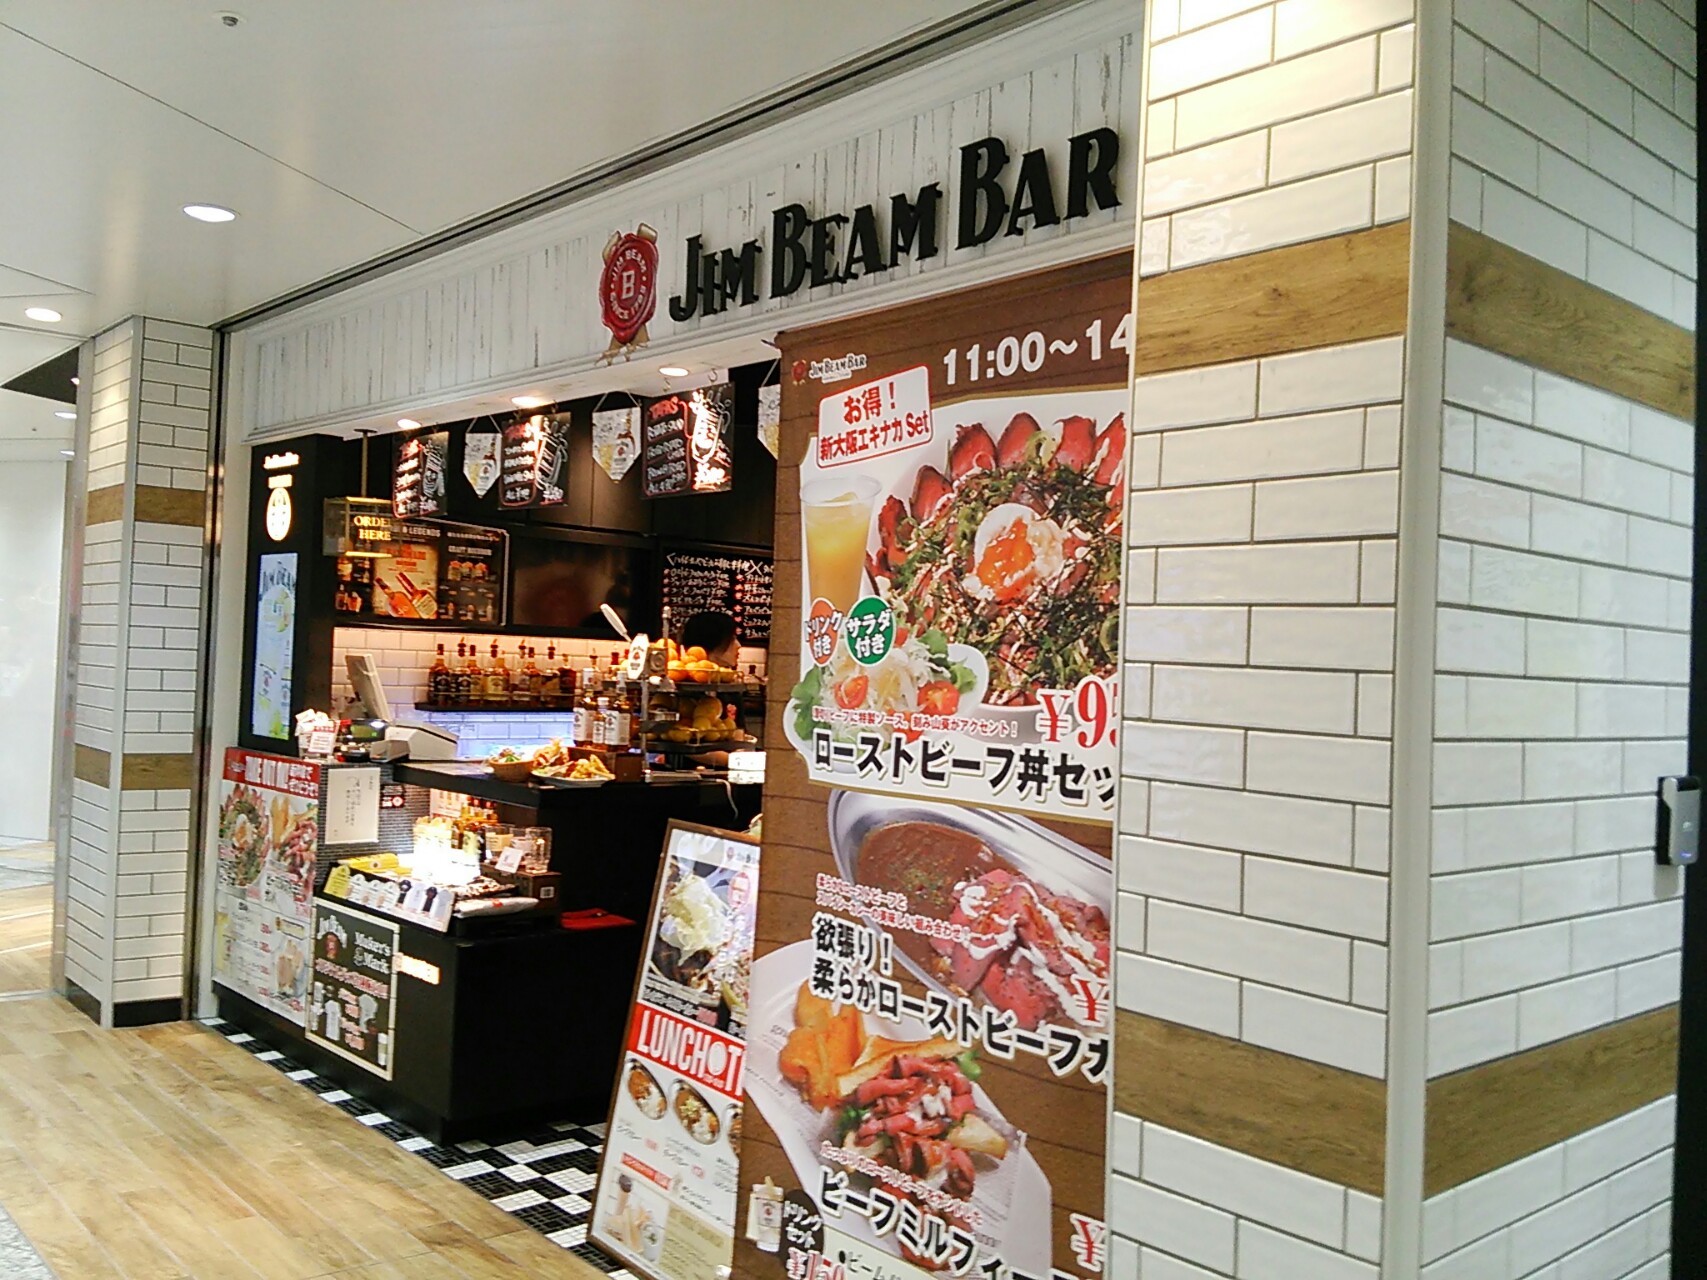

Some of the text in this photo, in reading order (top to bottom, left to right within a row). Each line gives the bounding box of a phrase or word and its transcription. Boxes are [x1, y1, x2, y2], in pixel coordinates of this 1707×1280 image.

[669, 126, 1122, 323] JIM BEAM BAR
[621, 269, 635, 300] B
[906, 410, 929, 437] Set
[359, 529, 392, 541] HERE
[846, 608, 892, 638] サラダ
[813, 634, 831, 659] 付き
[855, 633, 885, 659] 付き
[782, 1200, 823, 1232] ドリンク
[786, 1222, 816, 1249] セット
